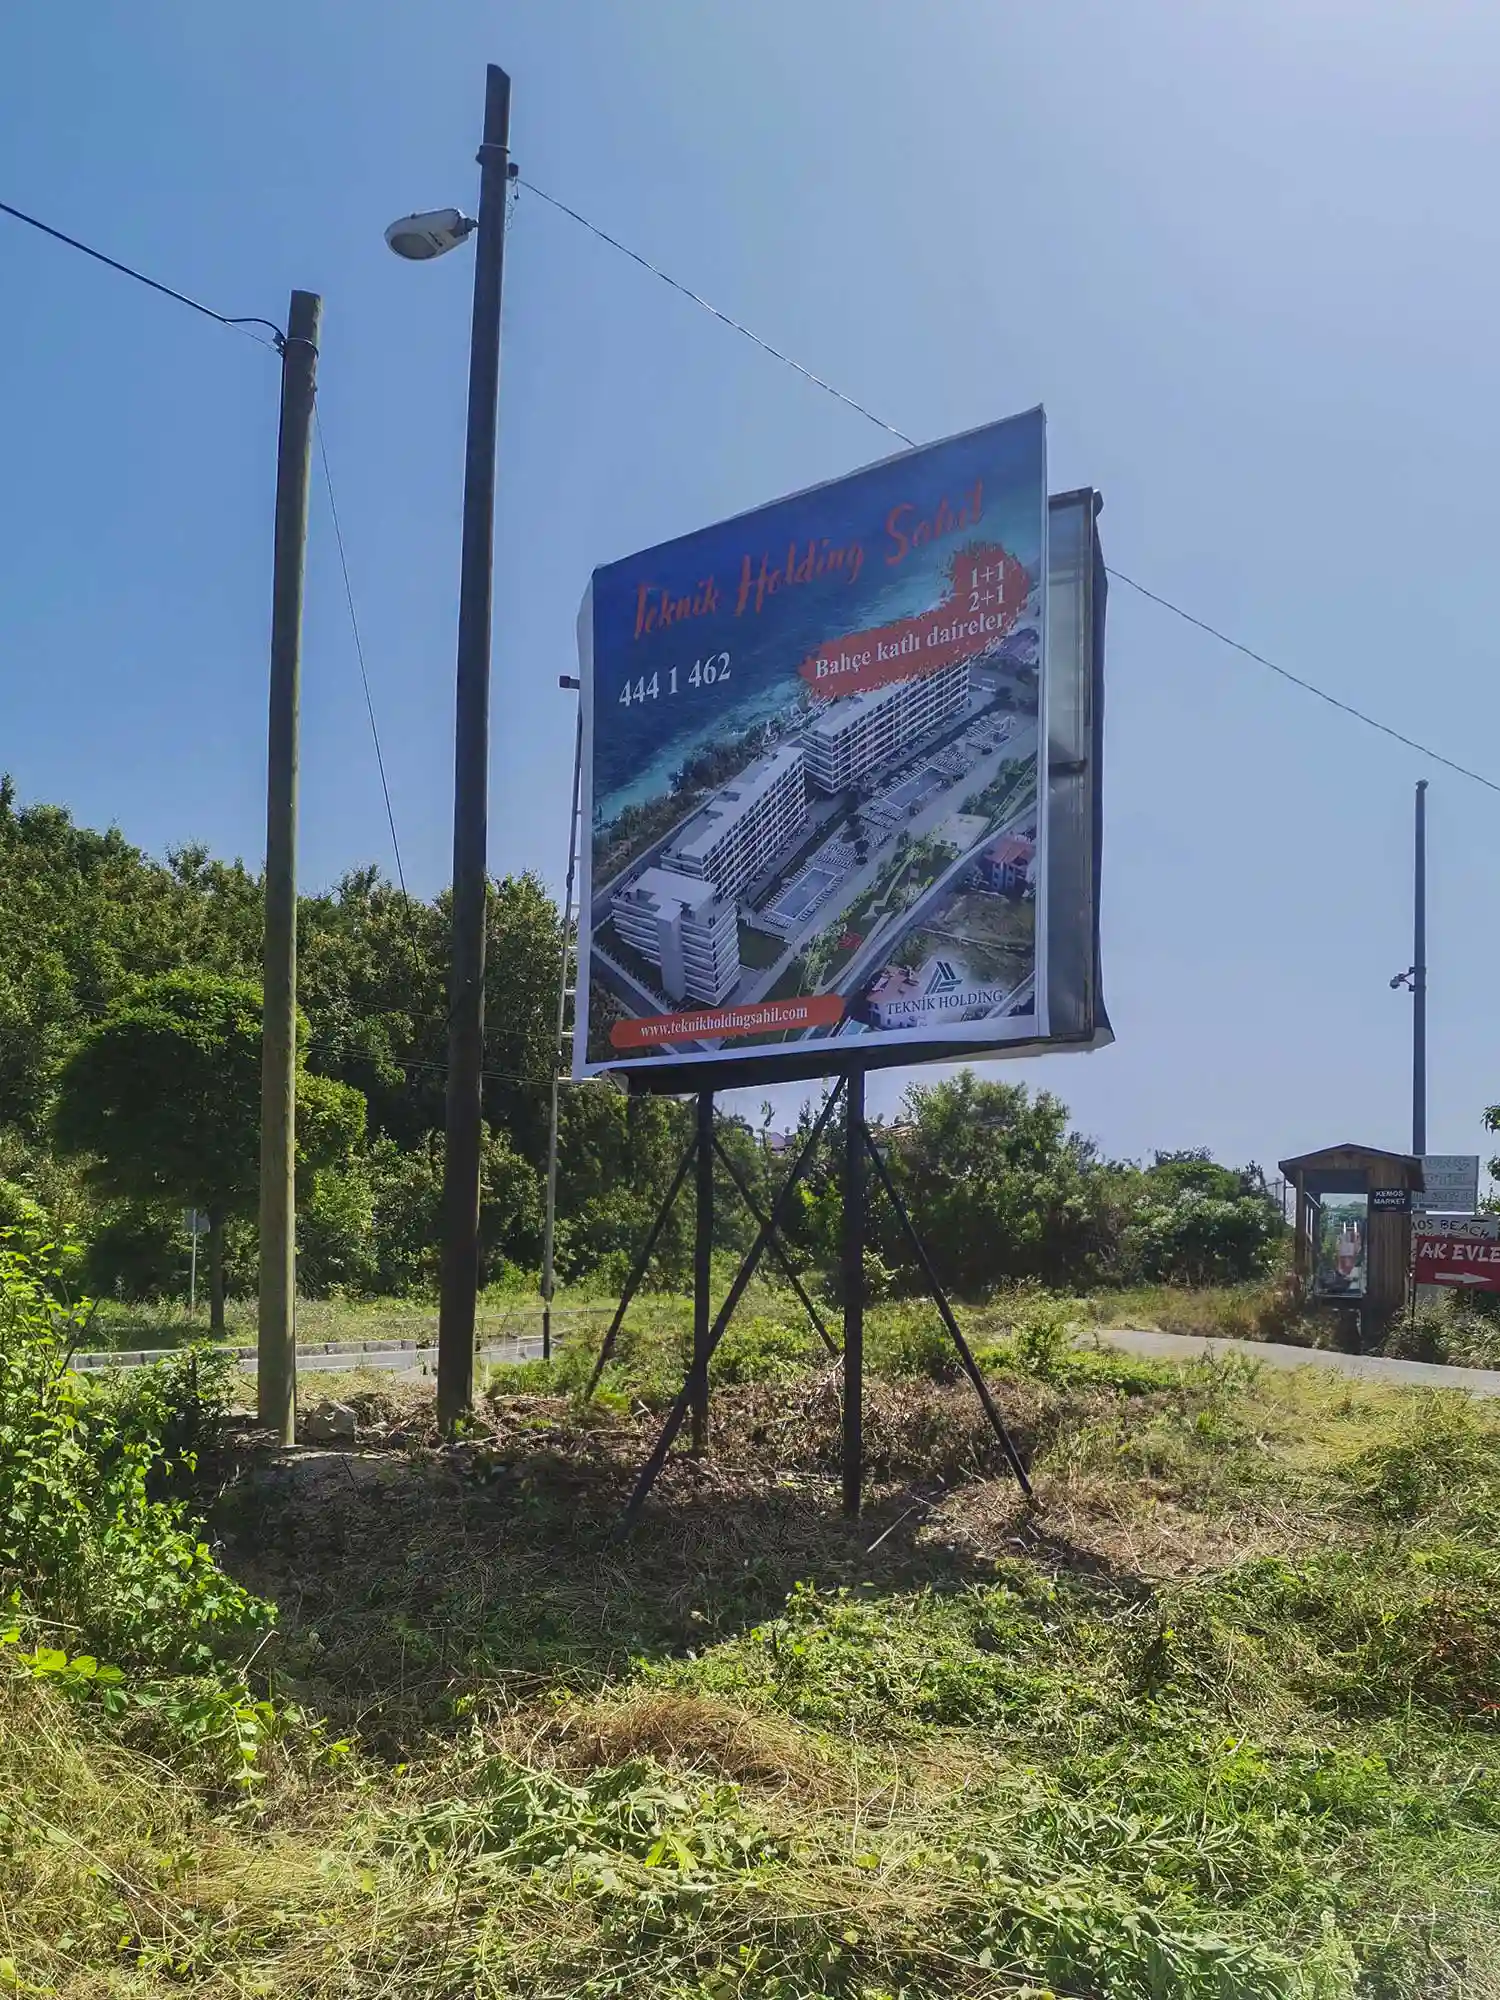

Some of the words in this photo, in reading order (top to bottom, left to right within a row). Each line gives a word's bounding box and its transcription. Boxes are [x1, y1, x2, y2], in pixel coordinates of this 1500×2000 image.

[634, 574, 720, 640] Teknik
[735, 537, 863, 617] Holding
[885, 476, 983, 566] Sahil
[971, 560, 1004, 588] 1+1
[969, 584, 1004, 612] 2+1
[815, 652, 872, 680] Bahçe
[876, 628, 920, 662] katlı
[926, 611, 1007, 648] daireler
[619, 671, 660, 706] 444
[668, 666, 678, 694] 1
[688, 652, 731, 688] 462
[640, 1005, 808, 1037] www.teknikholdingsahil.com
[1440, 1219, 1489, 1240] BEACH
[1420, 1242, 1448, 1260] AK
